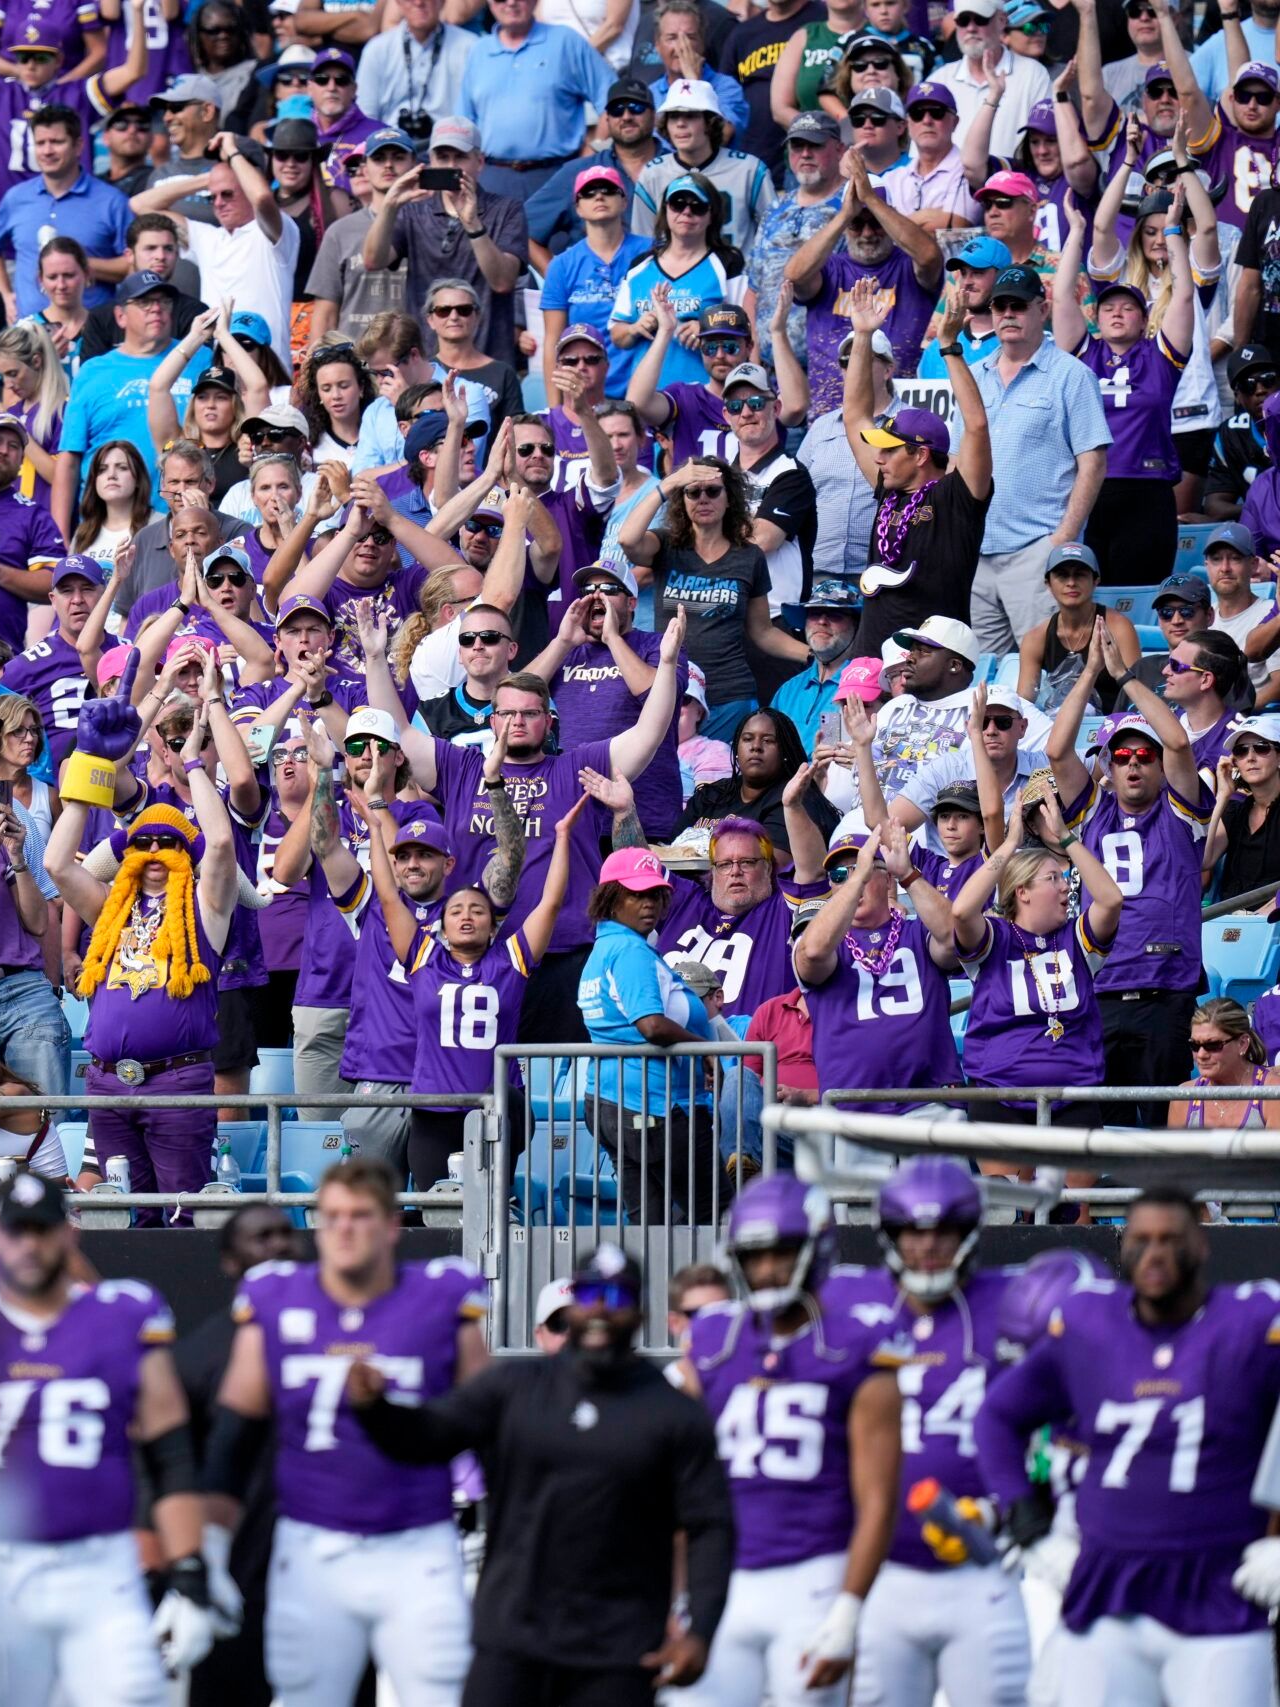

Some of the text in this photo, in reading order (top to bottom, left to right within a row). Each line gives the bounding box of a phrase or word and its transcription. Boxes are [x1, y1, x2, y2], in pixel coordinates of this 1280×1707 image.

[1099, 367, 1132, 407] 4
[664, 586, 738, 605] PANTHERS
[668, 571, 738, 592] CAROLINA
[851, 946, 924, 1021] 19
[1007, 949, 1079, 1015] 18
[438, 982, 500, 1050] 18
[327, 1137, 339, 1147] 23
[514, 1231, 569, 1240] 11 12
[718, 1382, 830, 1481] 45
[1095, 1396, 1204, 1493] 71
